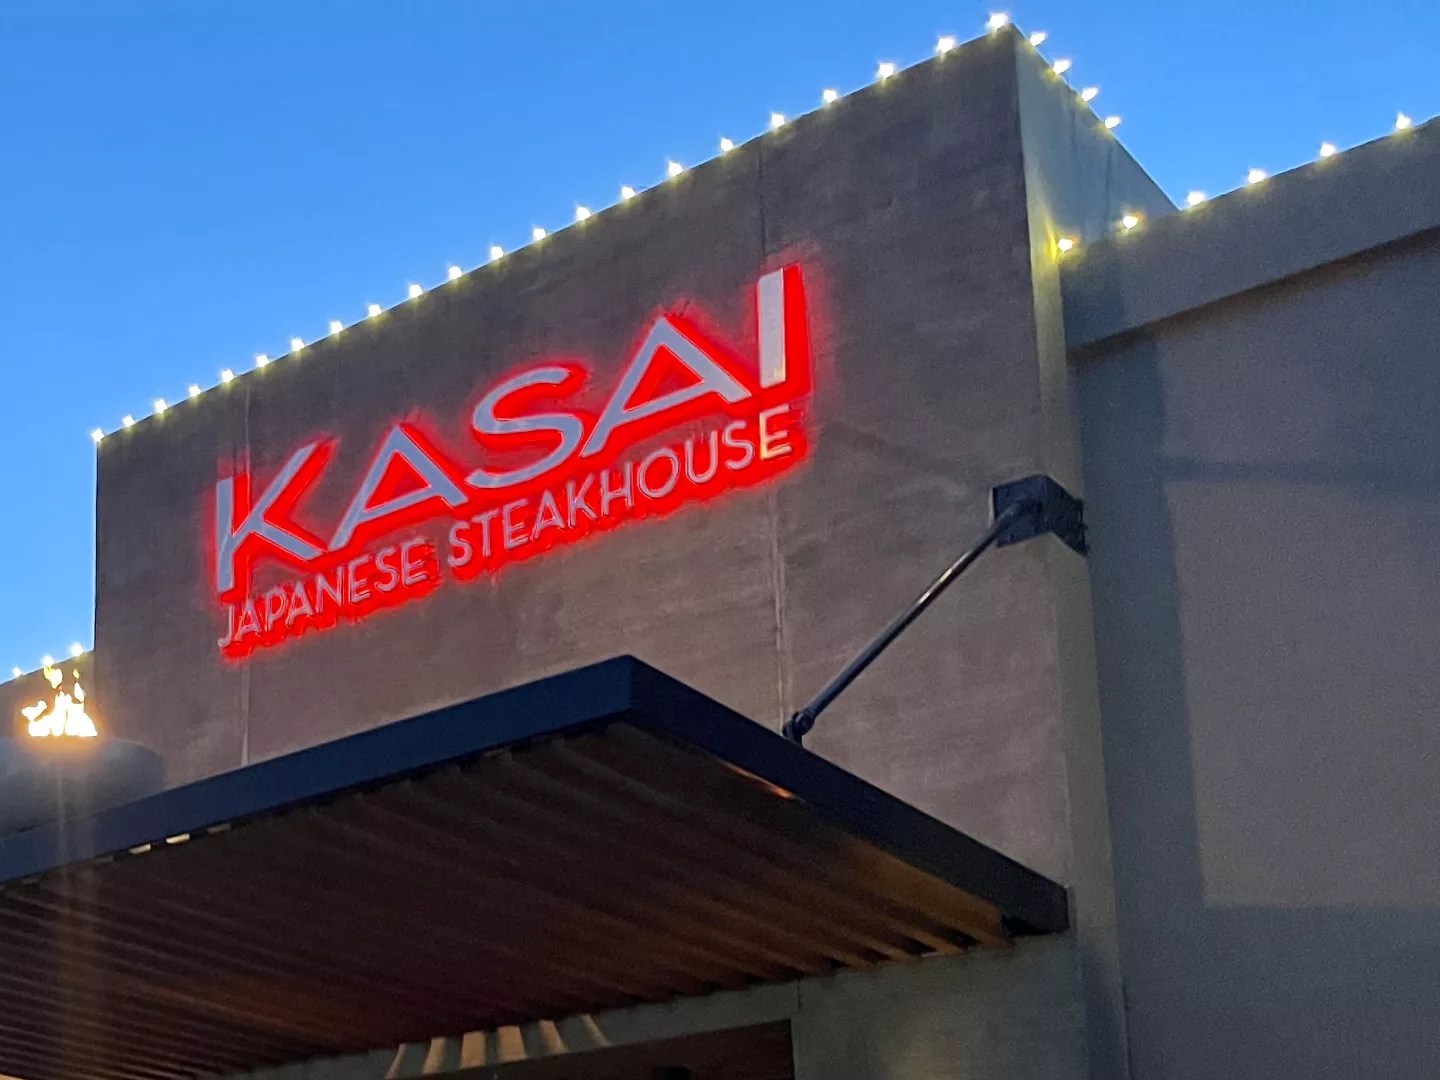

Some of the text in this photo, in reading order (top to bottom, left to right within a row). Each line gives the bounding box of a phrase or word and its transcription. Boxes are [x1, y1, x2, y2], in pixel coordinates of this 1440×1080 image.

[215, 267, 786, 593] KASAI
[218, 403, 794, 648] JAPANESE STEAKHOUSE
